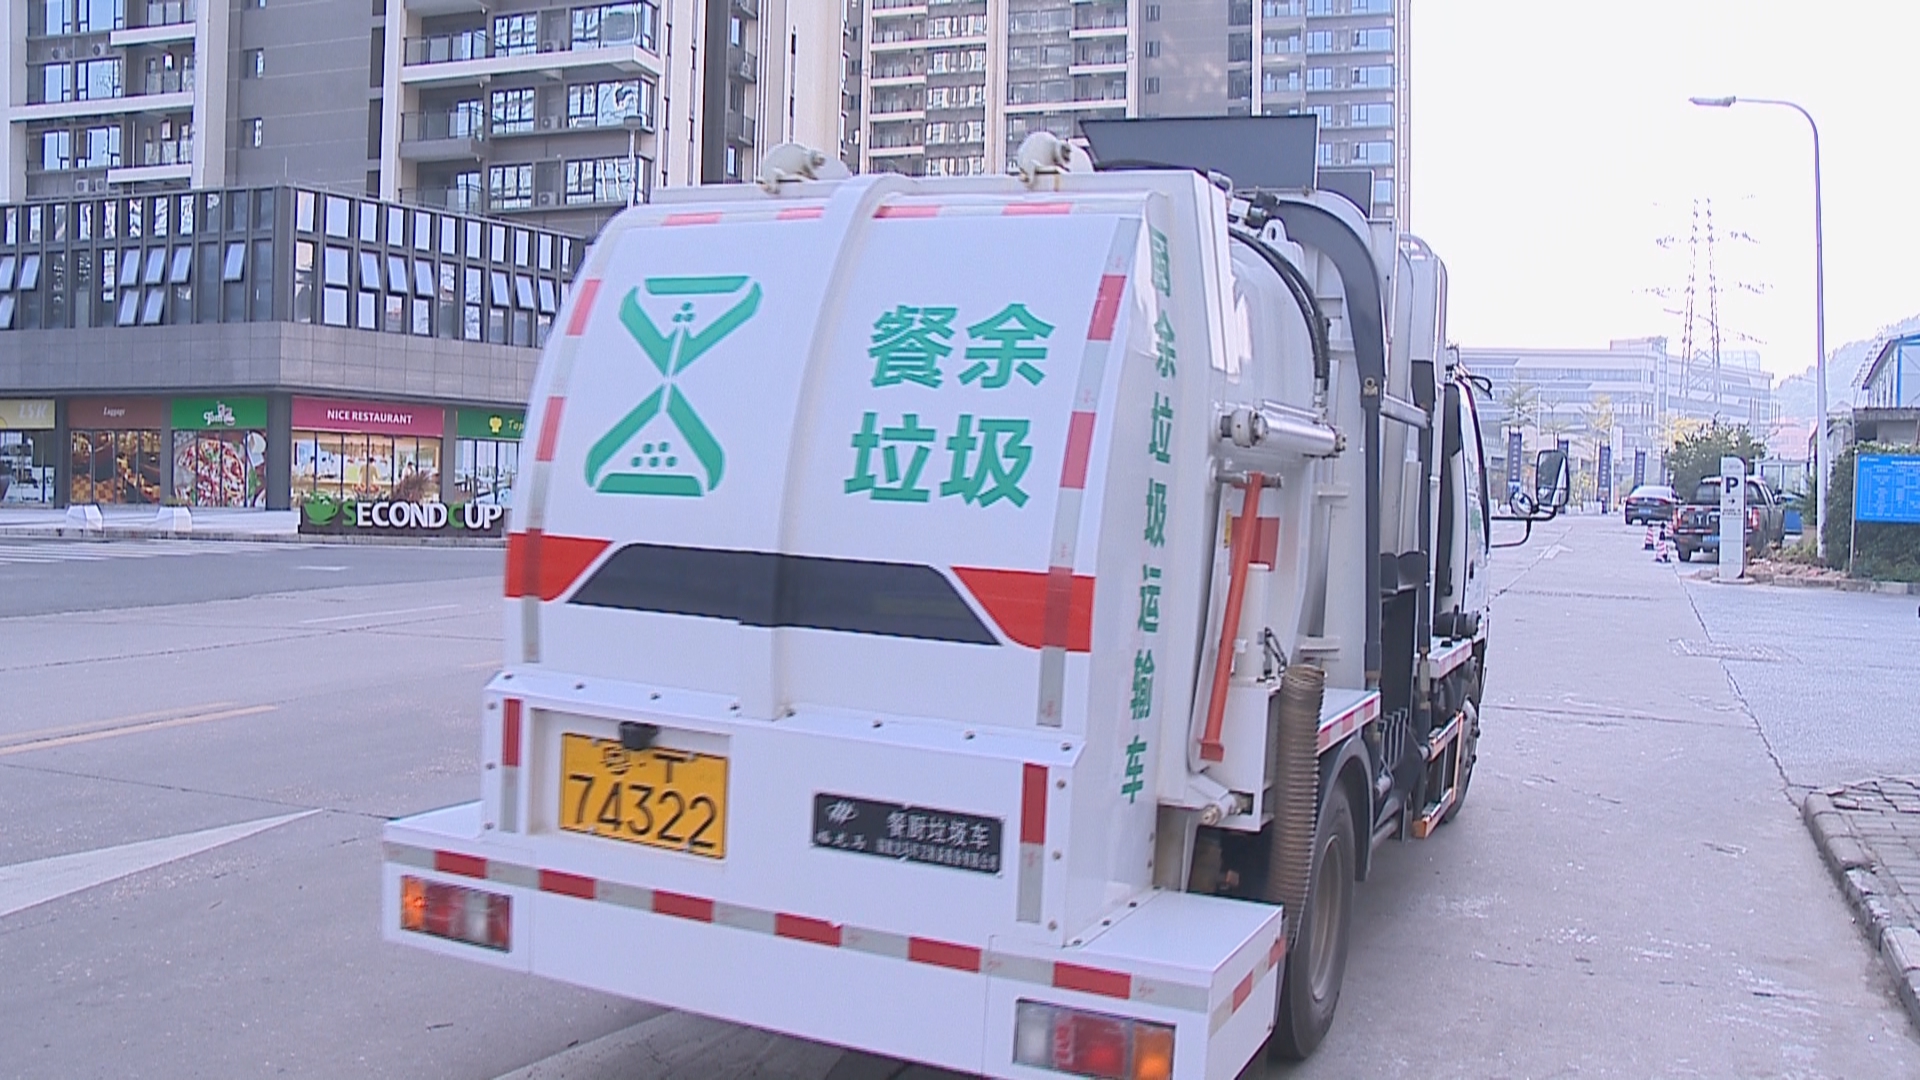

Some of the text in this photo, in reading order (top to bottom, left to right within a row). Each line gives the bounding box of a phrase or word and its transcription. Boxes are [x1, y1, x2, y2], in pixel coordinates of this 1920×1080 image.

[867, 303, 1056, 389] 餐余
[327, 409, 413, 424] NICE RESTAURANT
[844, 411, 1033, 509] 垃圾
[1726, 477, 1739, 494] P
[343, 501, 502, 529] SECOND CUP
[568, 773, 718, 849] 74322
